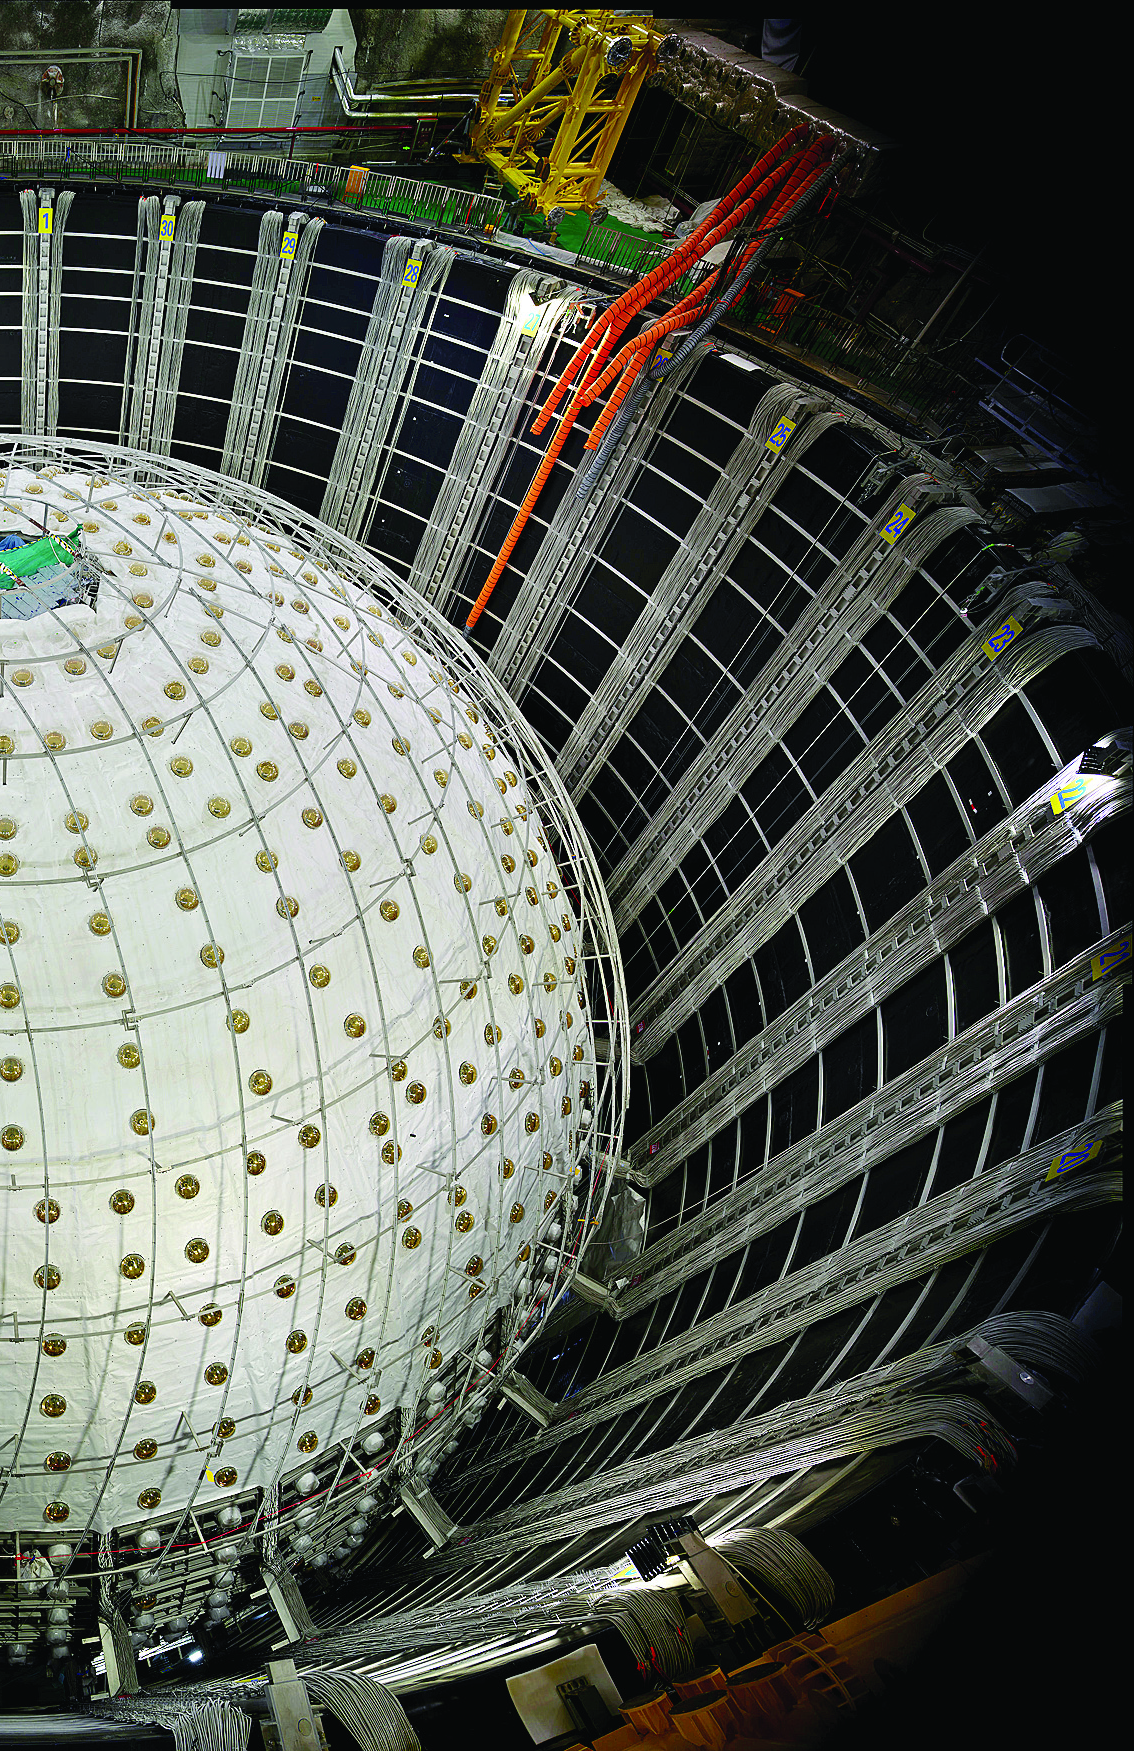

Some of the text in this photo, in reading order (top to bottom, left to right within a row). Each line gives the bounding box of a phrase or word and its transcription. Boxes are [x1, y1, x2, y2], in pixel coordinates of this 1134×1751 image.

[42, 212, 49, 229] 1
[161, 220, 173, 236] 30
[282, 237, 295, 254] 29
[404, 264, 419, 283] 28
[523, 313, 541, 331] 27
[769, 423, 791, 448] 25
[885, 510, 909, 539] 24
[988, 624, 1015, 653] 23
[1099, 941, 1130, 974] 21
[1056, 1142, 1094, 1174] 20
